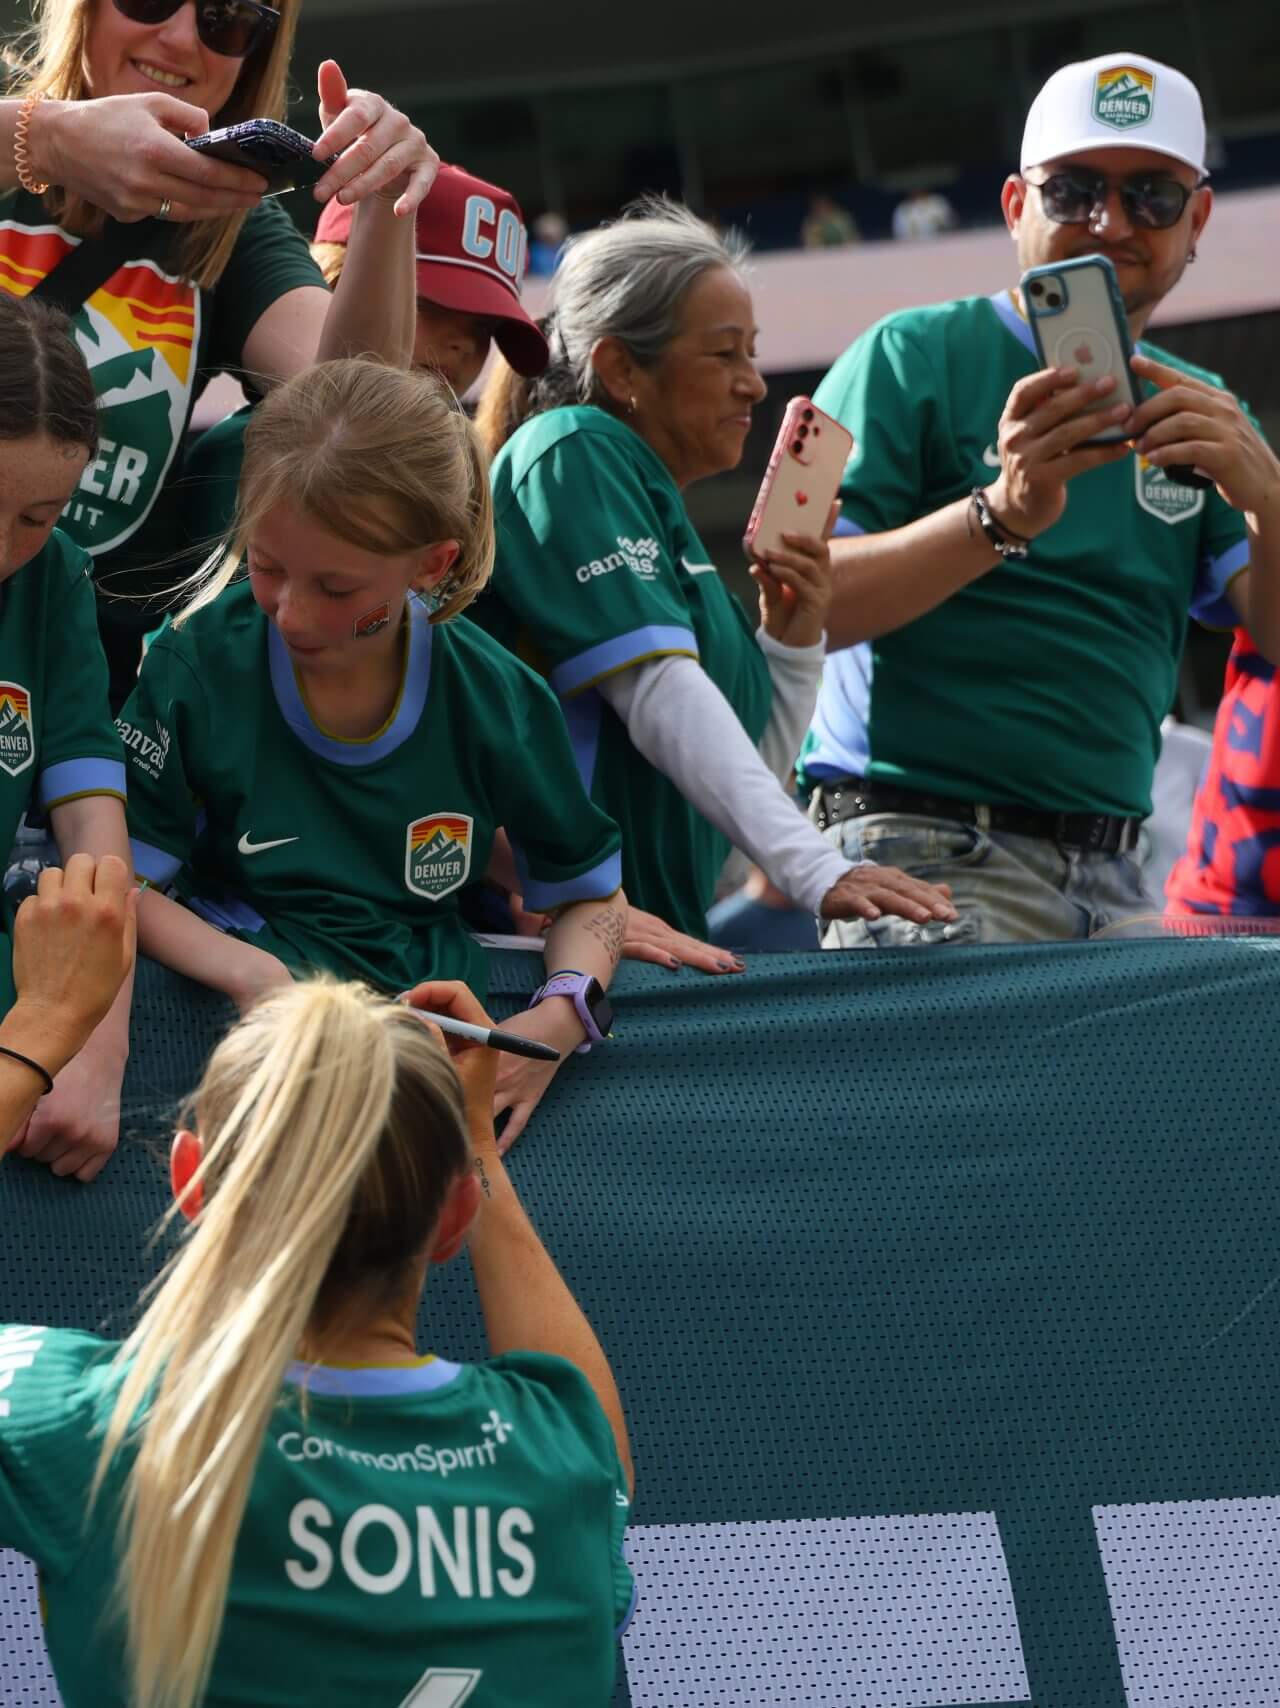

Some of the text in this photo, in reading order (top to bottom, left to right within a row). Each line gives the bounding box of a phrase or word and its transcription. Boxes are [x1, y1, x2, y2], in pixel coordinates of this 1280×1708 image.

[1098, 99, 1147, 116] DENVER
[1145, 484, 1194, 502] DENVER
[414, 860, 461, 879] DENVER
[277, 1431, 497, 1478] CommonSpirit
[284, 1497, 536, 1599] SONIS
